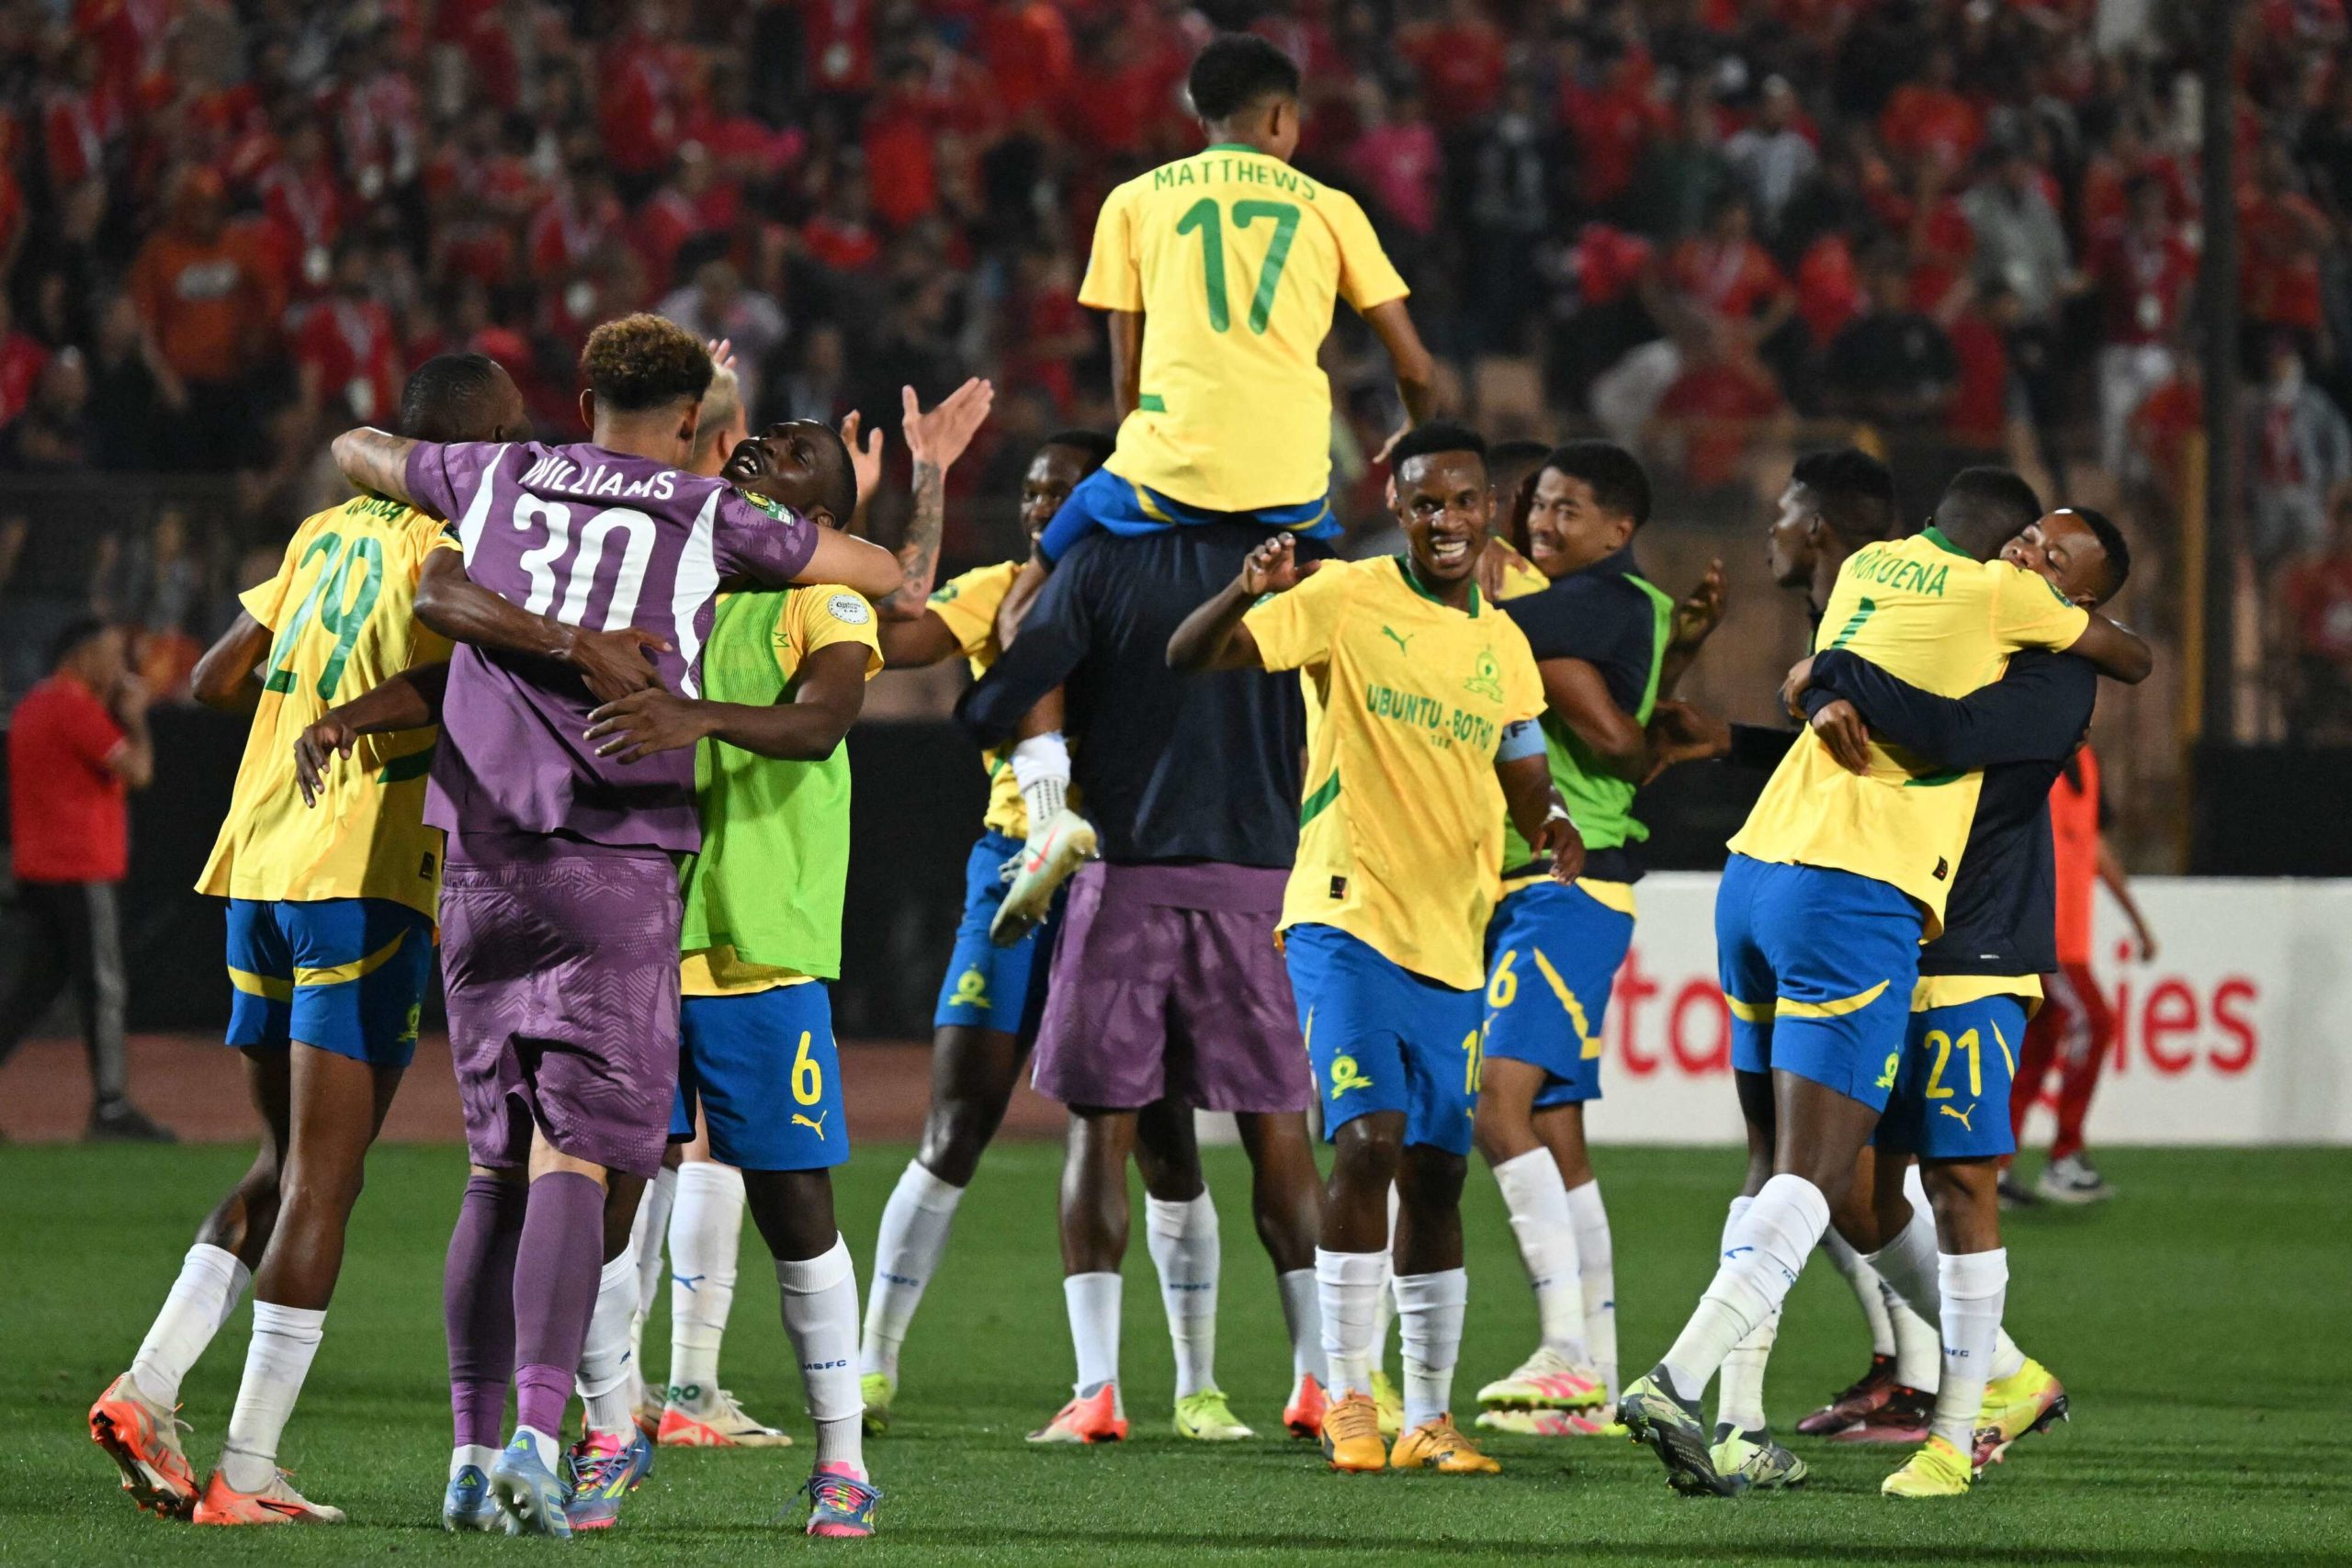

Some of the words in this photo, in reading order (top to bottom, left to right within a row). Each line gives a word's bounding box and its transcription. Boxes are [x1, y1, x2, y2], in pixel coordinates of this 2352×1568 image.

[1154, 158, 1317, 201] MATTHEWS
[1176, 197, 1301, 334] 17
[517, 456, 677, 500] WILLIAMS
[513, 492, 657, 632] 30
[265, 531, 383, 701] 29
[1366, 682, 1442, 729] UBUNTU
[1487, 950, 1518, 1009] 6
[791, 1030, 822, 1106] 6
[1924, 1028, 1982, 1099] 21
[801, 1359, 847, 1371] MSFC
